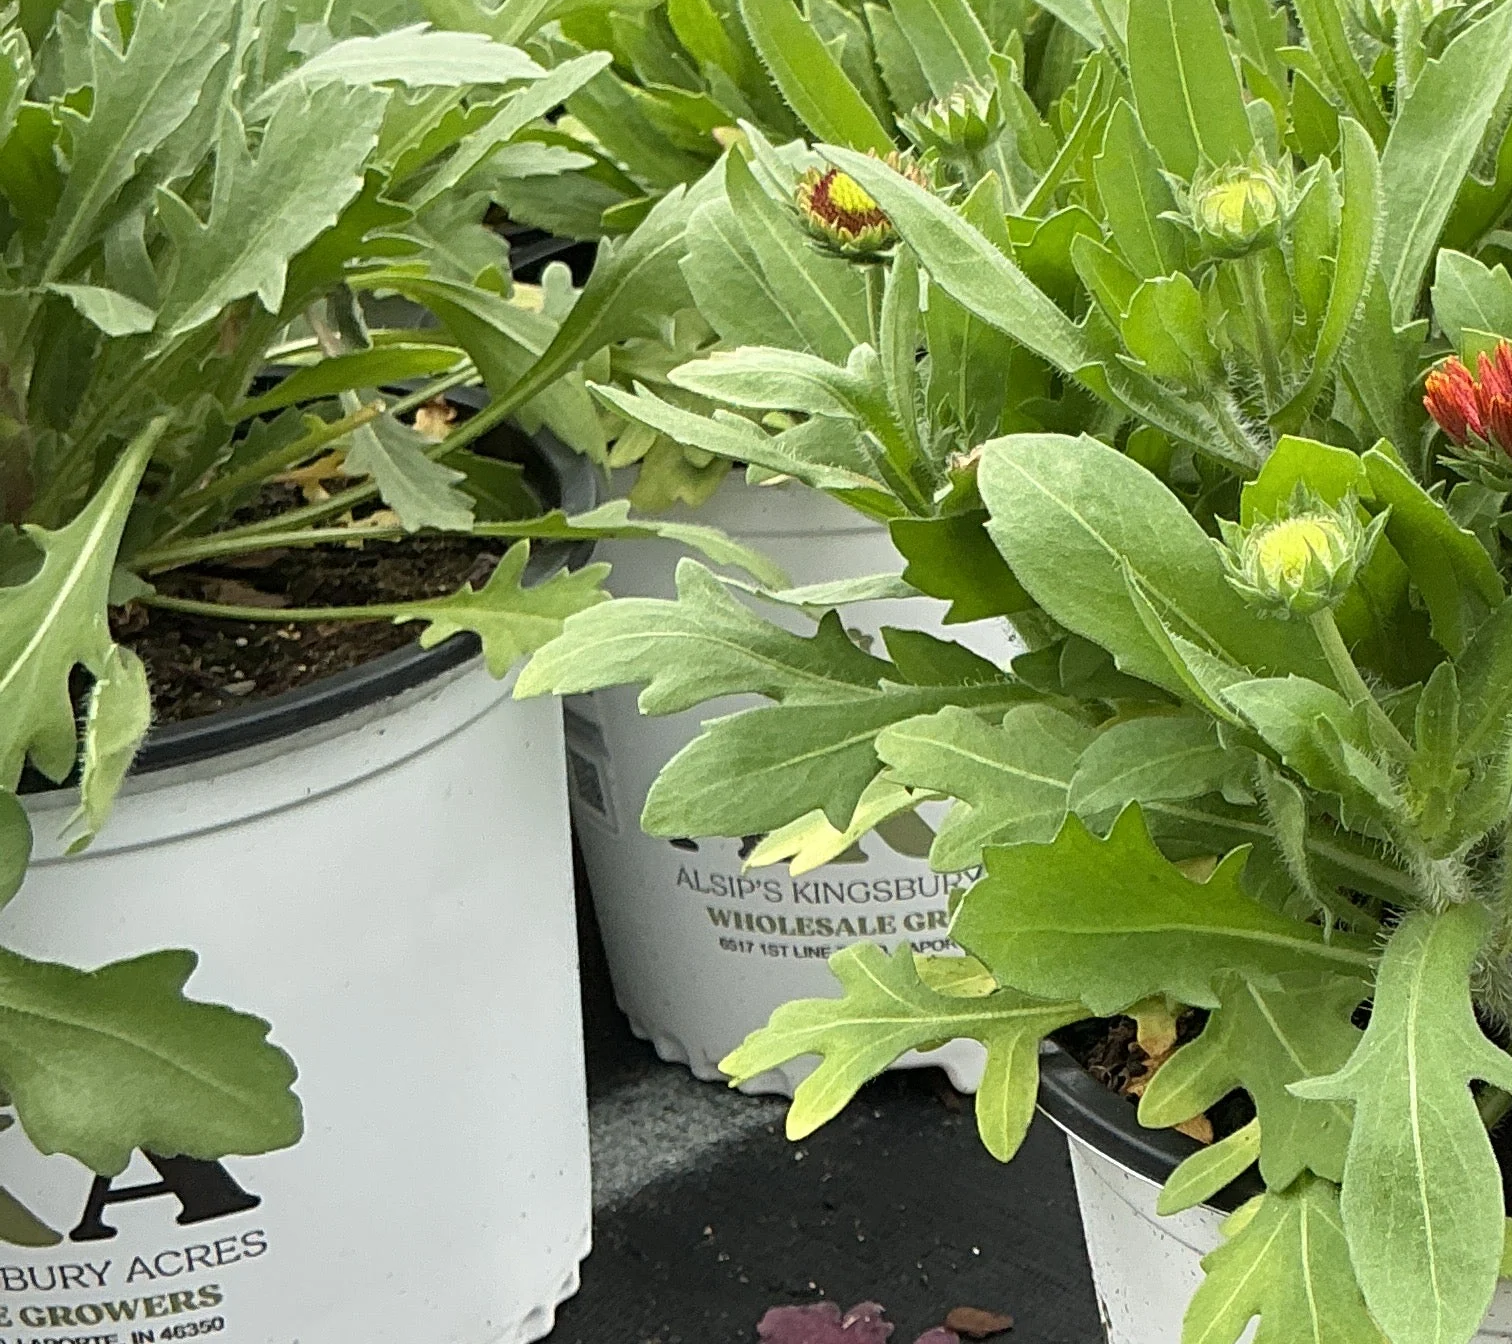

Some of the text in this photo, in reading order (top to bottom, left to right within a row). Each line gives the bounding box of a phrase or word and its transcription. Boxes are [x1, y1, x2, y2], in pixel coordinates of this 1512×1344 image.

[676, 862, 984, 905] ALSIP'S KINGSBURY
[706, 906, 897, 937] WHOLESALE
[758, 943, 789, 957] 1ST
[126, 1229, 268, 1284] ACRES
[19, 1284, 224, 1328] GROWERS
[160, 1316, 225, 1341] 46350
